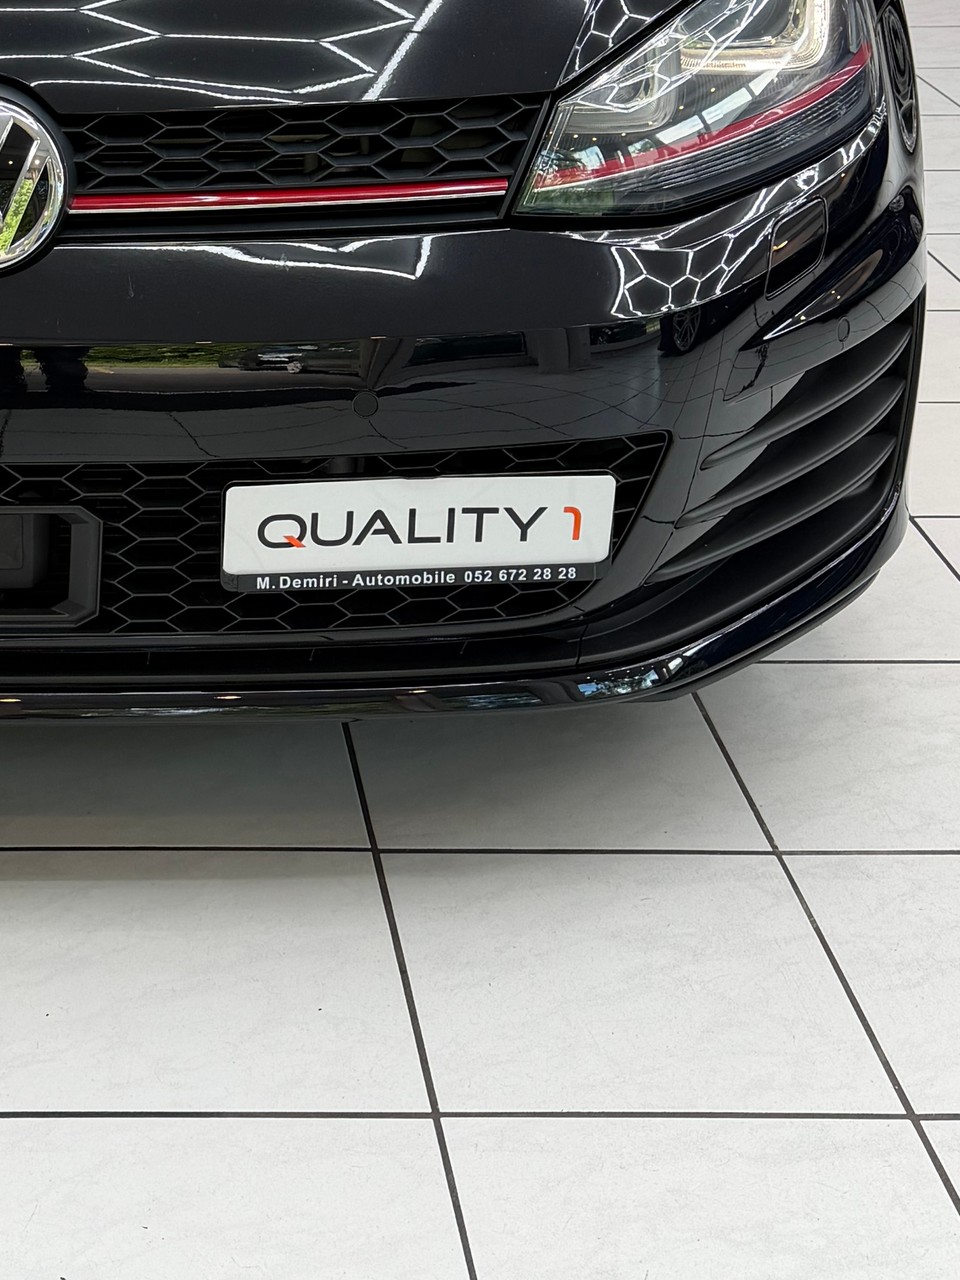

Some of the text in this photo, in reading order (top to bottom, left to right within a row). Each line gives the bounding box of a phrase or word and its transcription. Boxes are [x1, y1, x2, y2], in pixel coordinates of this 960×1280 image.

[257, 506, 582, 549] QUALITY 1
[464, 570, 493, 583] 052
[499, 569, 527, 582] 672
[533, 567, 552, 580] 28
[558, 566, 577, 580] 28
